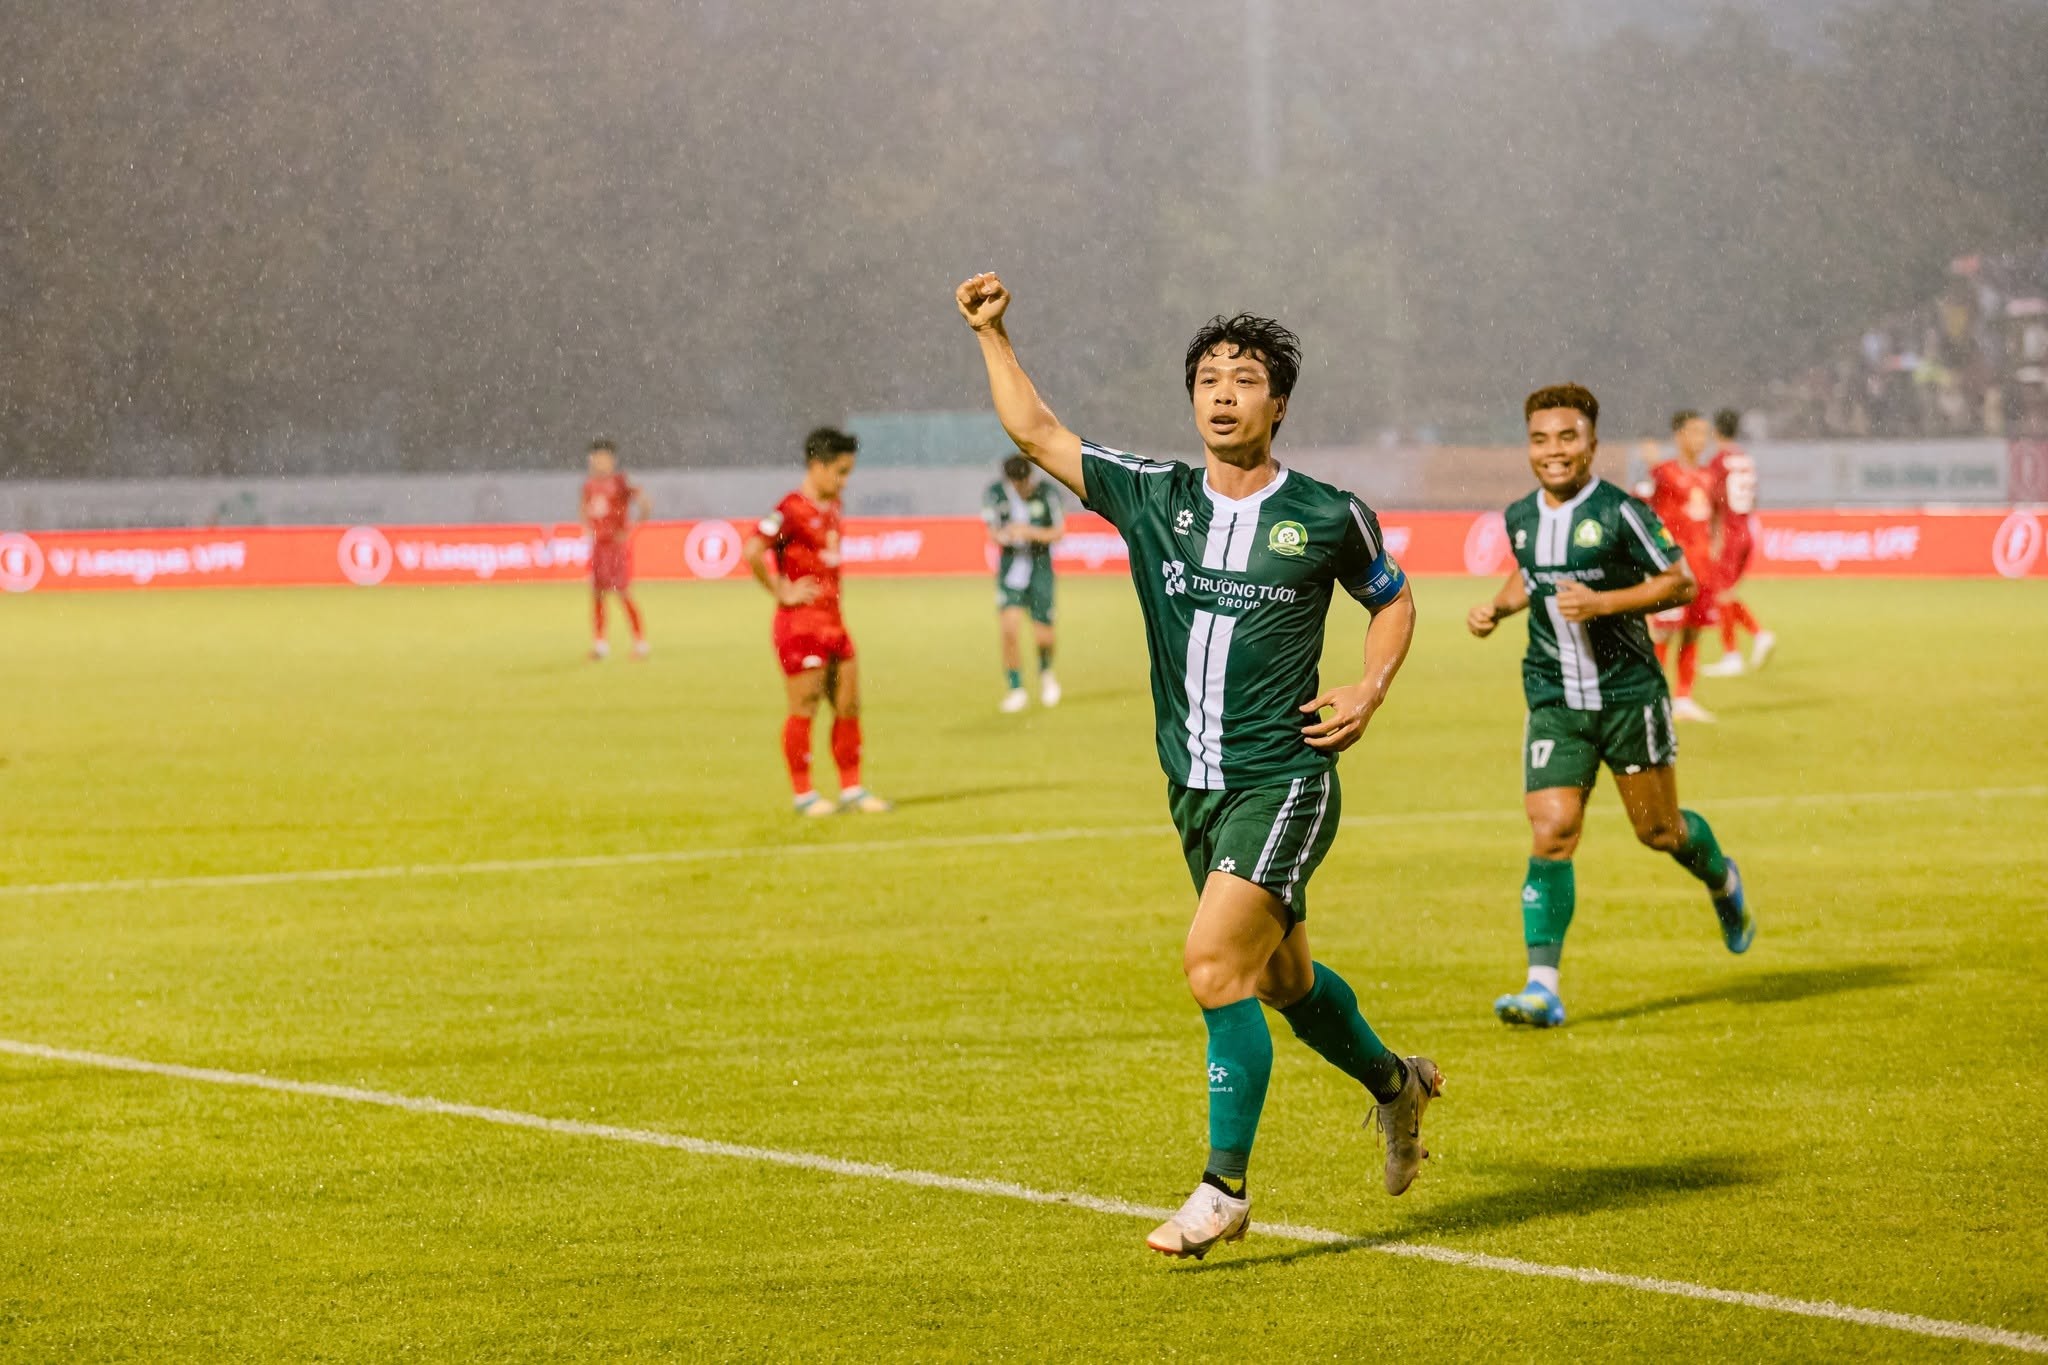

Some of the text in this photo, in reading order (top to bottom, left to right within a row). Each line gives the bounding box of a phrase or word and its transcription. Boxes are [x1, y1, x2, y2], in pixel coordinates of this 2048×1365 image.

[1191, 574, 1297, 603] TRƯỜNG TƯƠI
[1217, 596, 1261, 610] GROUP
[1530, 739, 1556, 769] 17
